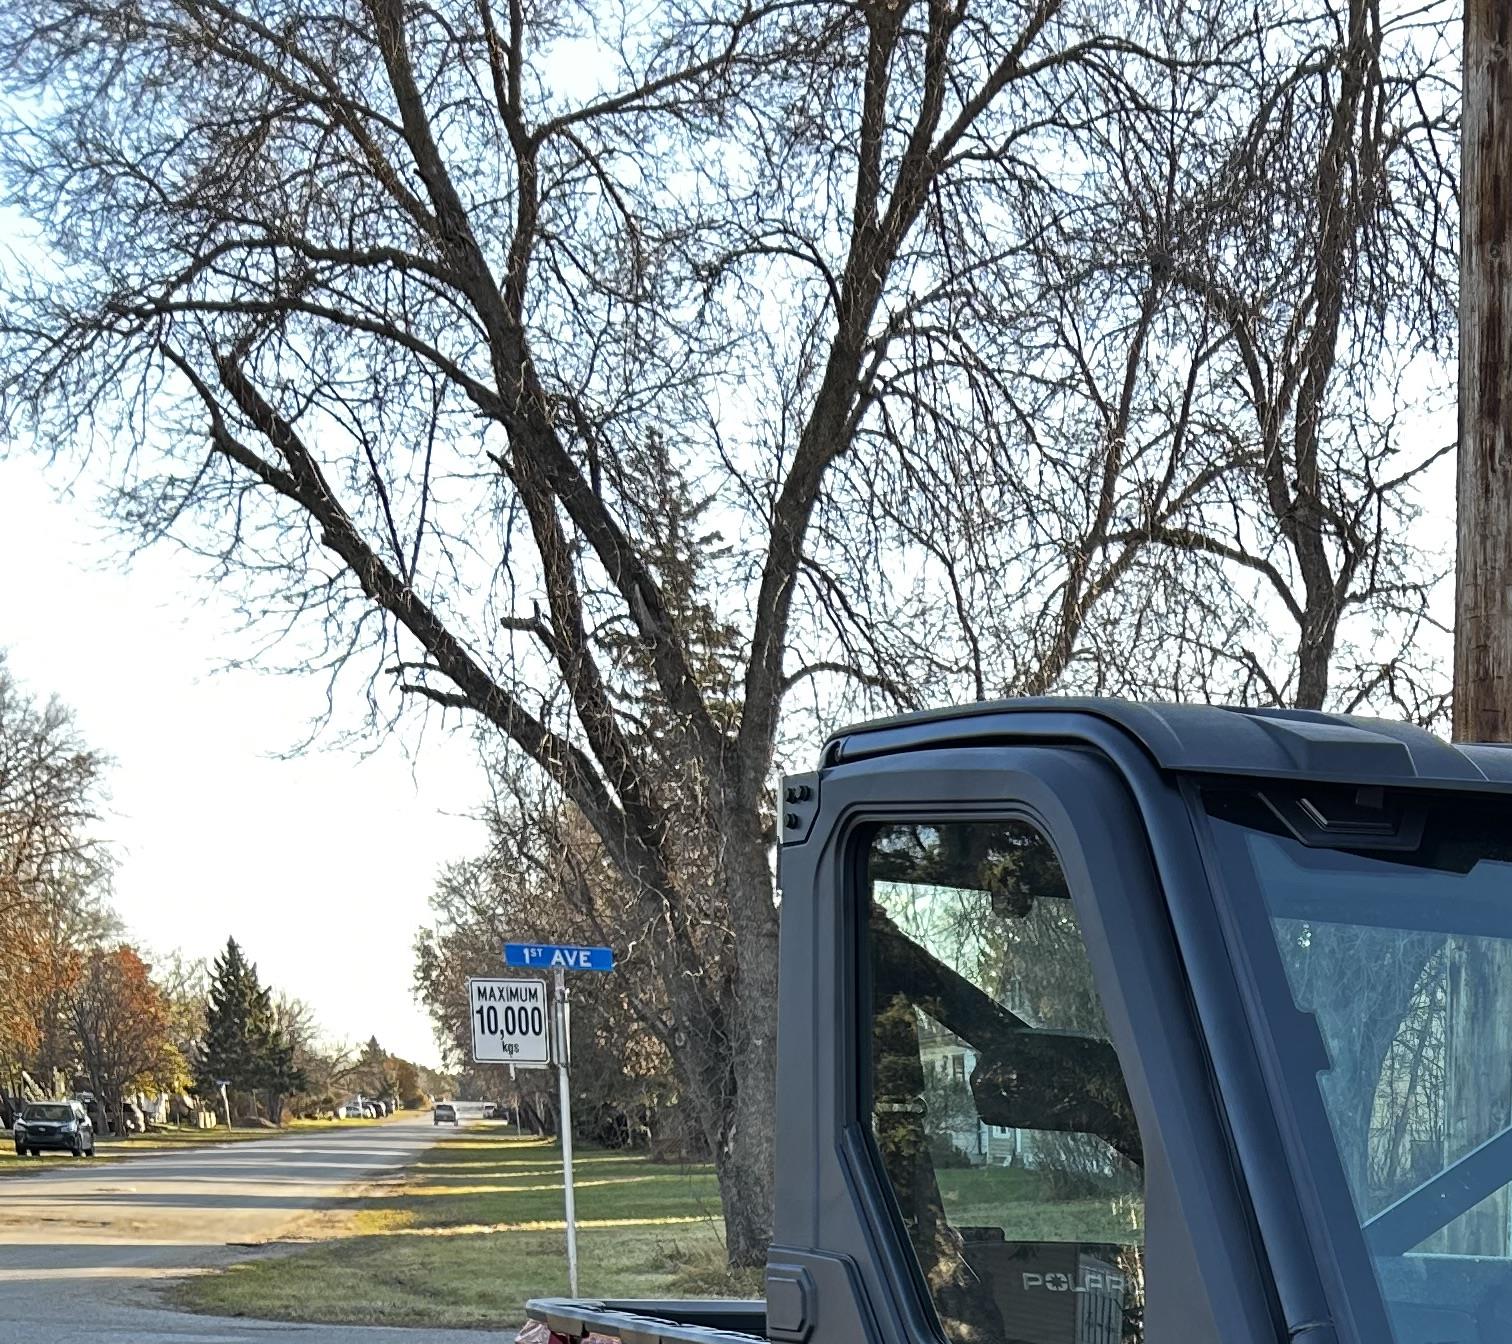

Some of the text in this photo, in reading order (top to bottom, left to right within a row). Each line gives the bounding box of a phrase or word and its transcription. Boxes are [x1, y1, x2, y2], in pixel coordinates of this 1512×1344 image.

[522, 947, 592, 968] 1ST AVE
[477, 986, 539, 1002] MAXIMUM
[475, 1005, 543, 1040] 10,000
[501, 1040, 520, 1056] kgs
